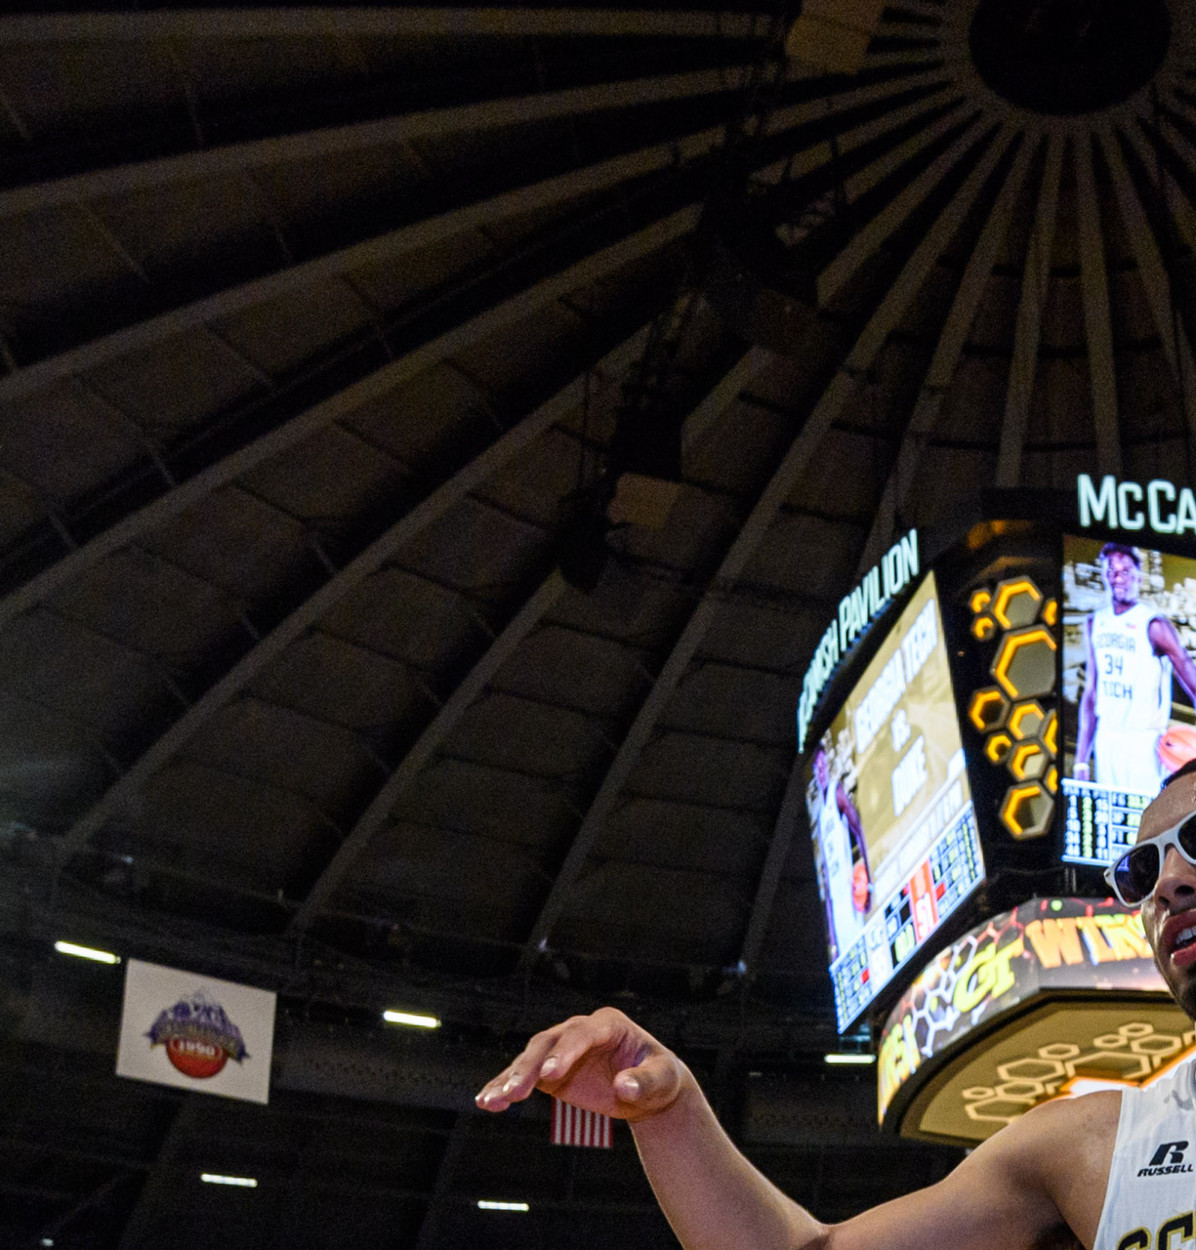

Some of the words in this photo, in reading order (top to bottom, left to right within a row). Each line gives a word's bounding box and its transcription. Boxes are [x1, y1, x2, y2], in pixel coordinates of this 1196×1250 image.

[838, 527, 919, 652] PAVILION
[1104, 654, 1124, 675] 34
[1025, 914, 1156, 969] WIN
[953, 937, 1024, 1013] GT
[1137, 1164, 1194, 1178] RUSSELL
